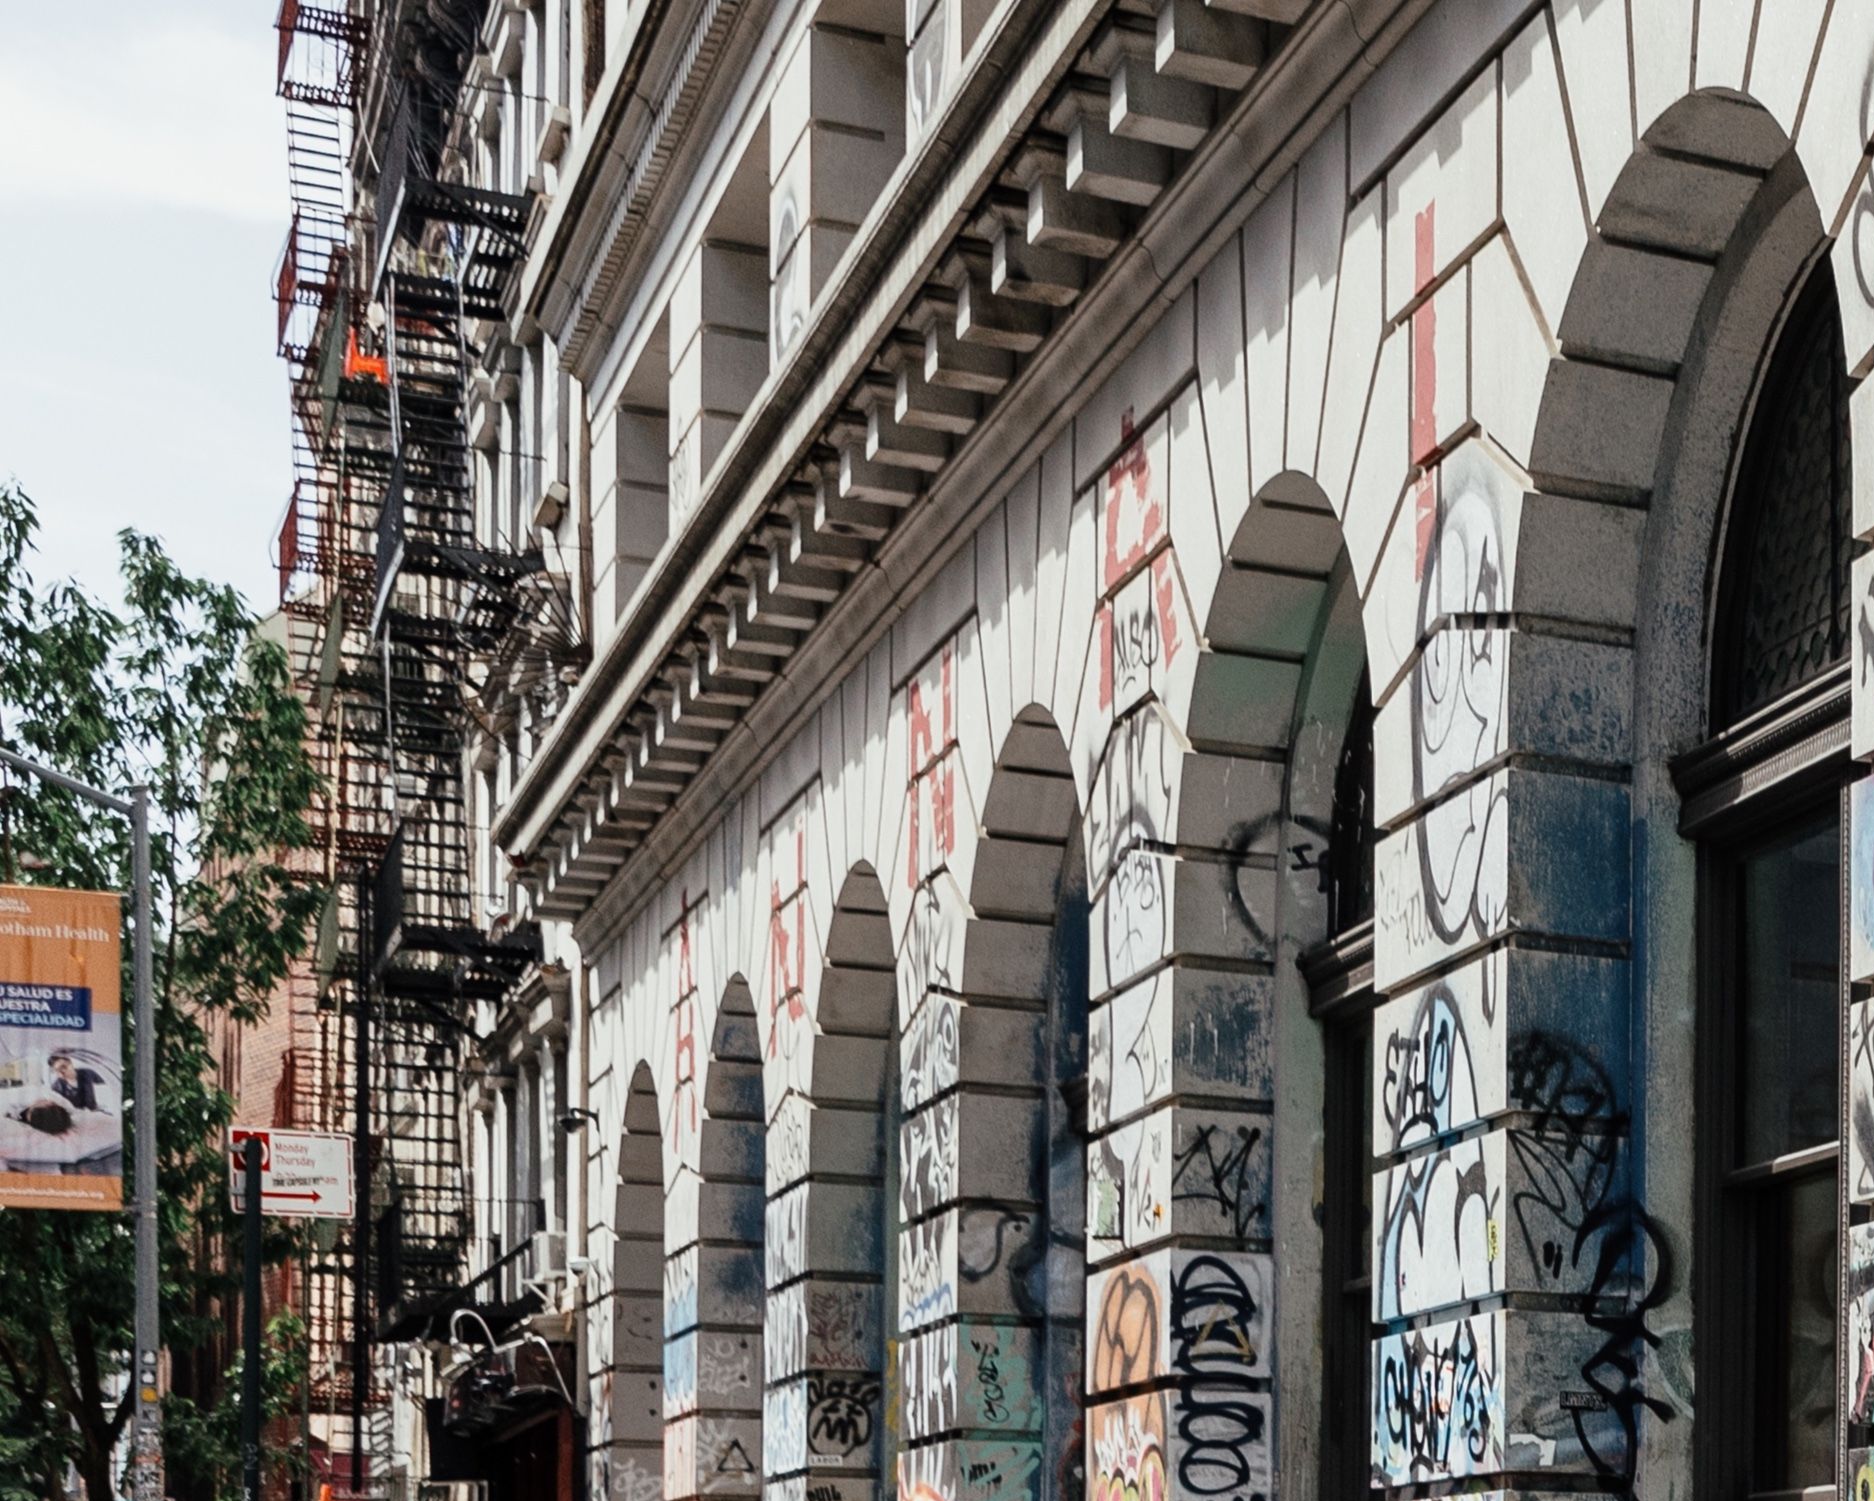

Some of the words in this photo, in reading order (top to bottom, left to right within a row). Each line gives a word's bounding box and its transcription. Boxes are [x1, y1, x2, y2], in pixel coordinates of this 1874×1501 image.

[0, 921, 52, 943] otham
[55, 924, 110, 943] Health
[7, 986, 53, 1000] SALUD
[55, 988, 73, 1001] ES
[275, 1143, 309, 1155] Monday
[275, 1155, 316, 1168] Thursday
